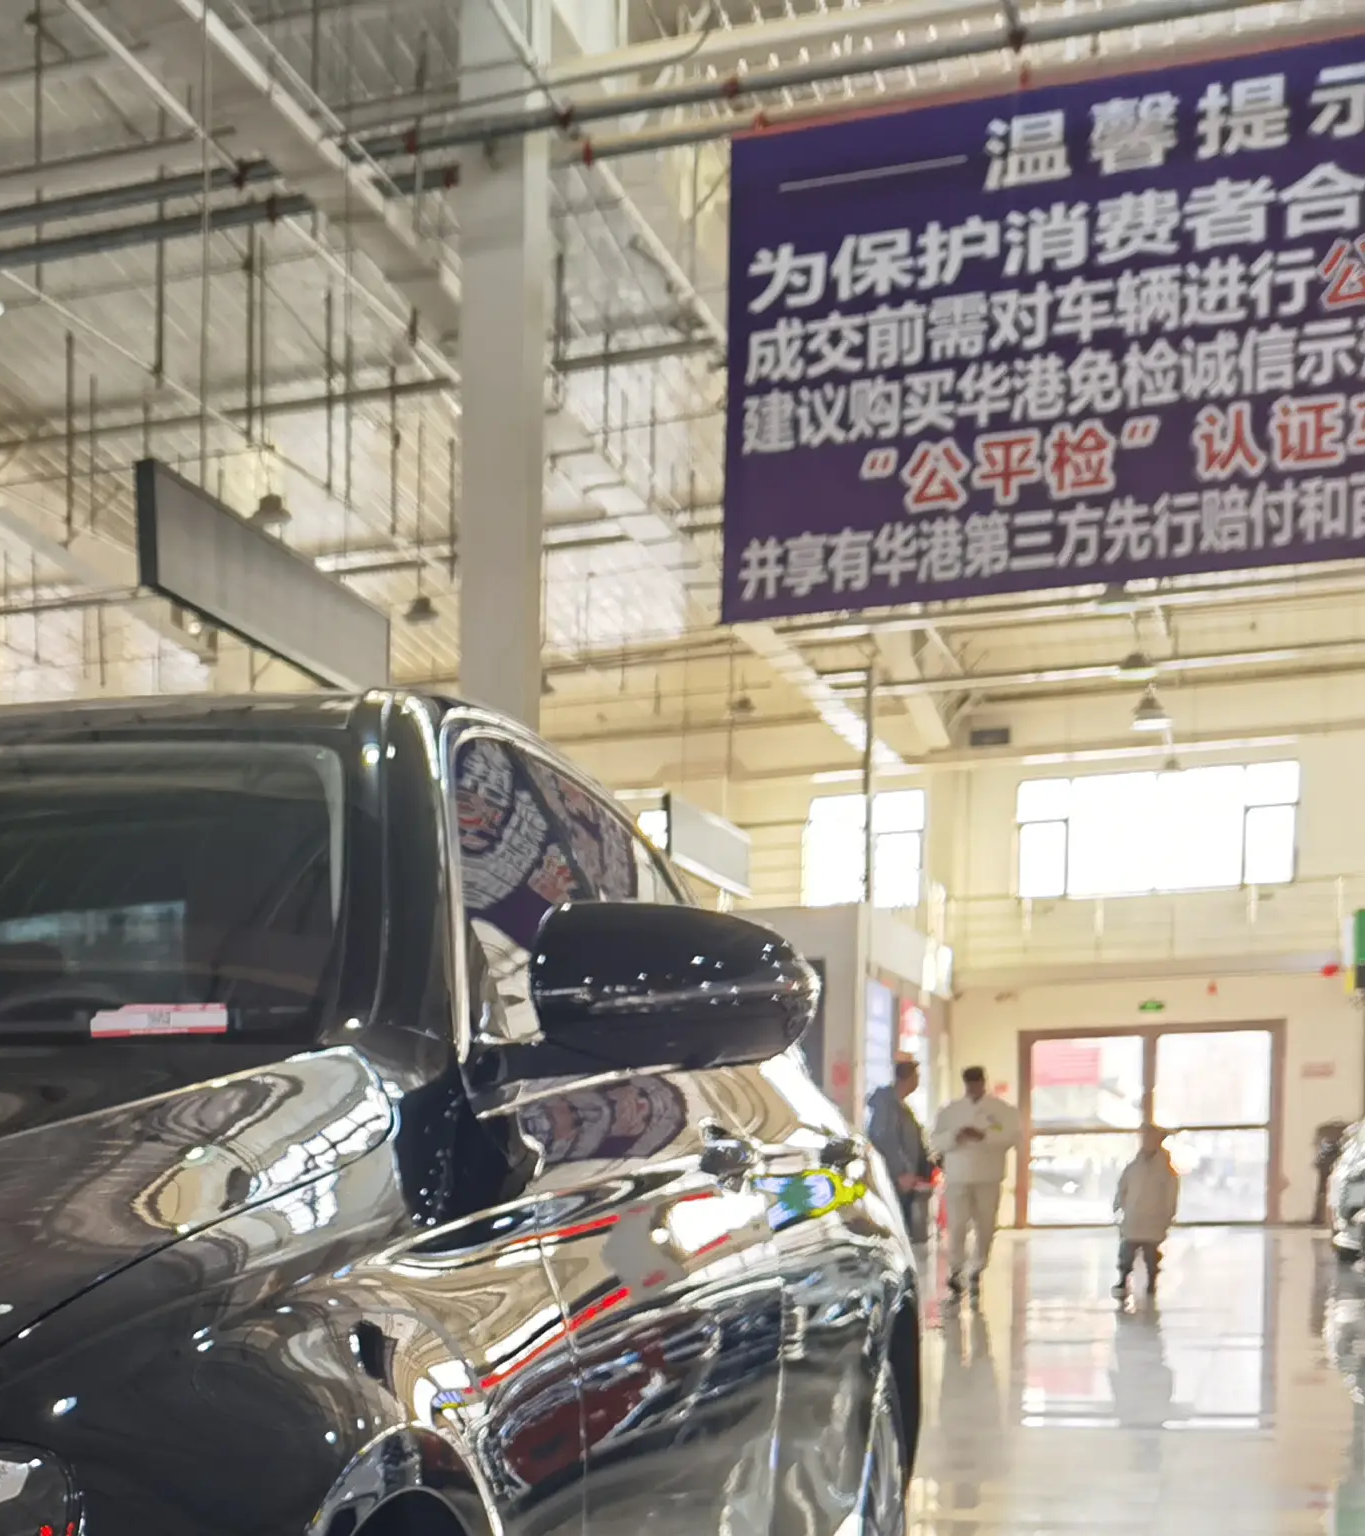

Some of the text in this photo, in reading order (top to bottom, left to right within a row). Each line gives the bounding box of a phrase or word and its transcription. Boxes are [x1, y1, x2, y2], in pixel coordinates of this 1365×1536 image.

[747, 161, 1365, 314] 为保护消费者合
[741, 317, 1365, 455] 建议购买华港免检诚信示
